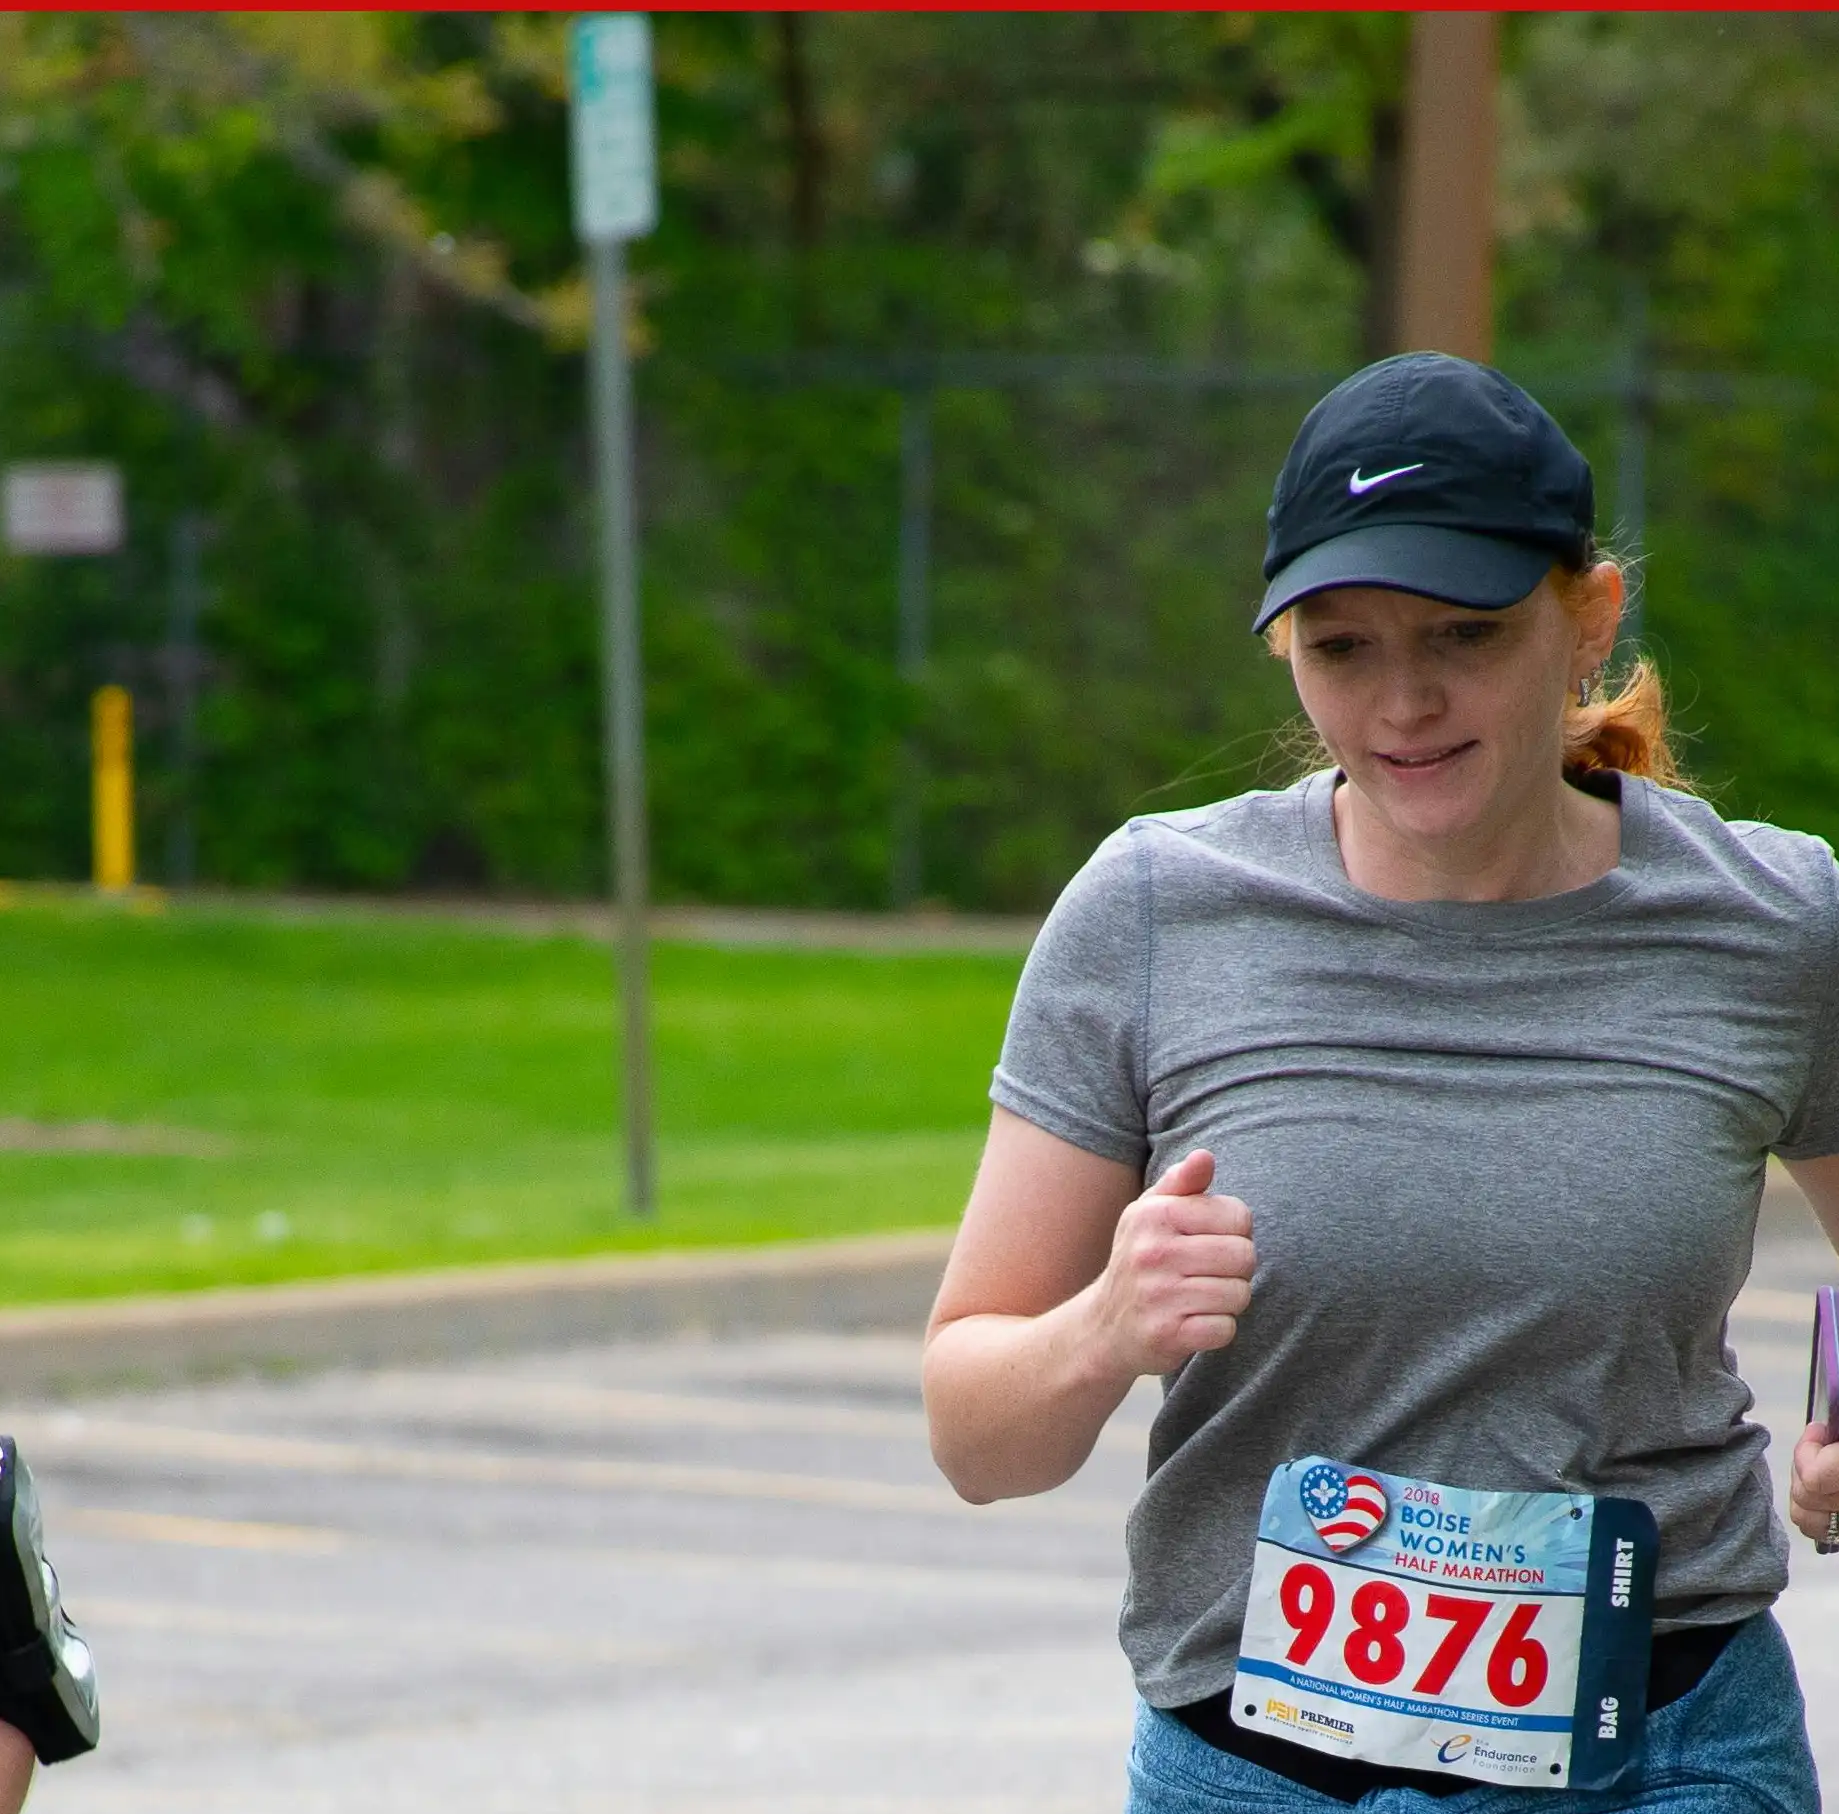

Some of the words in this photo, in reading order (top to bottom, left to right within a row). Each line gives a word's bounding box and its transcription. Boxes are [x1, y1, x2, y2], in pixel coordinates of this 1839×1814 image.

[1404, 1487, 1440, 1506] 2018
[1401, 1505, 1471, 1535] BOISE
[1400, 1529, 1526, 1564] WOMEN'S
[1395, 1552, 1438, 1573] HALF
[1442, 1563, 1544, 1584] MARATHON
[1611, 1538, 1634, 1608] SHIRT
[1279, 1563, 1549, 1707] 9876
[1290, 1675, 1296, 1684] A
[1296, 1678, 1339, 1698] NATIONAL
[1340, 1688, 1382, 1706] WOMEN'S
[1383, 1698, 1405, 1710] HALF
[1407, 1703, 1459, 1719] MARATHON
[1461, 1711, 1490, 1724] SERIES
[1491, 1716, 1519, 1727] EVENT
[1300, 1710, 1354, 1734] PREMIER
[1598, 1696, 1619, 1739] BAG
[1472, 1757, 1536, 1773] Foundation
[1474, 1746, 1537, 1763] Endurance
